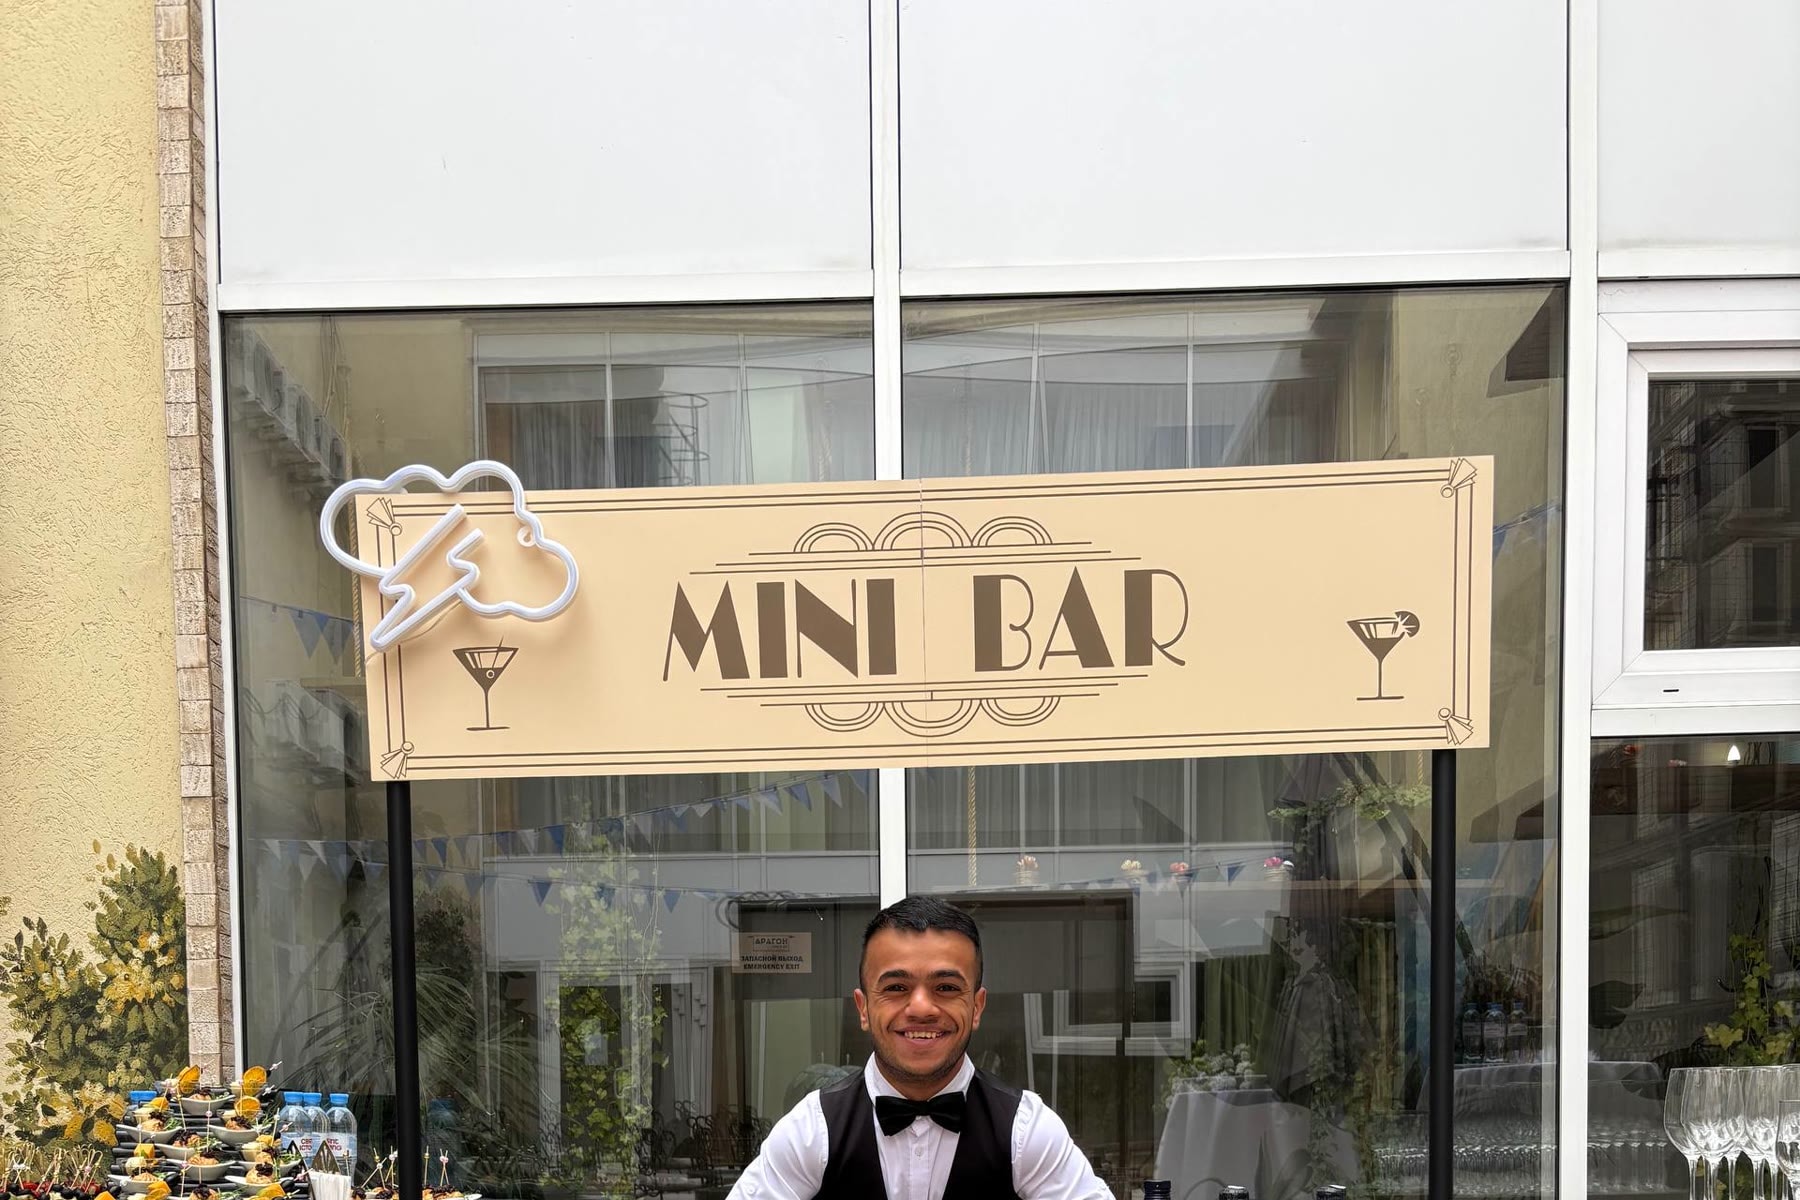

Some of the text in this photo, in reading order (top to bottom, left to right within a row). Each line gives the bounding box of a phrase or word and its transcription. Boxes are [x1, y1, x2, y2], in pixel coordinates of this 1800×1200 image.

[662, 566, 1189, 682] MINI BAR
[741, 954, 777, 962] ЗАПАСНОЙ
